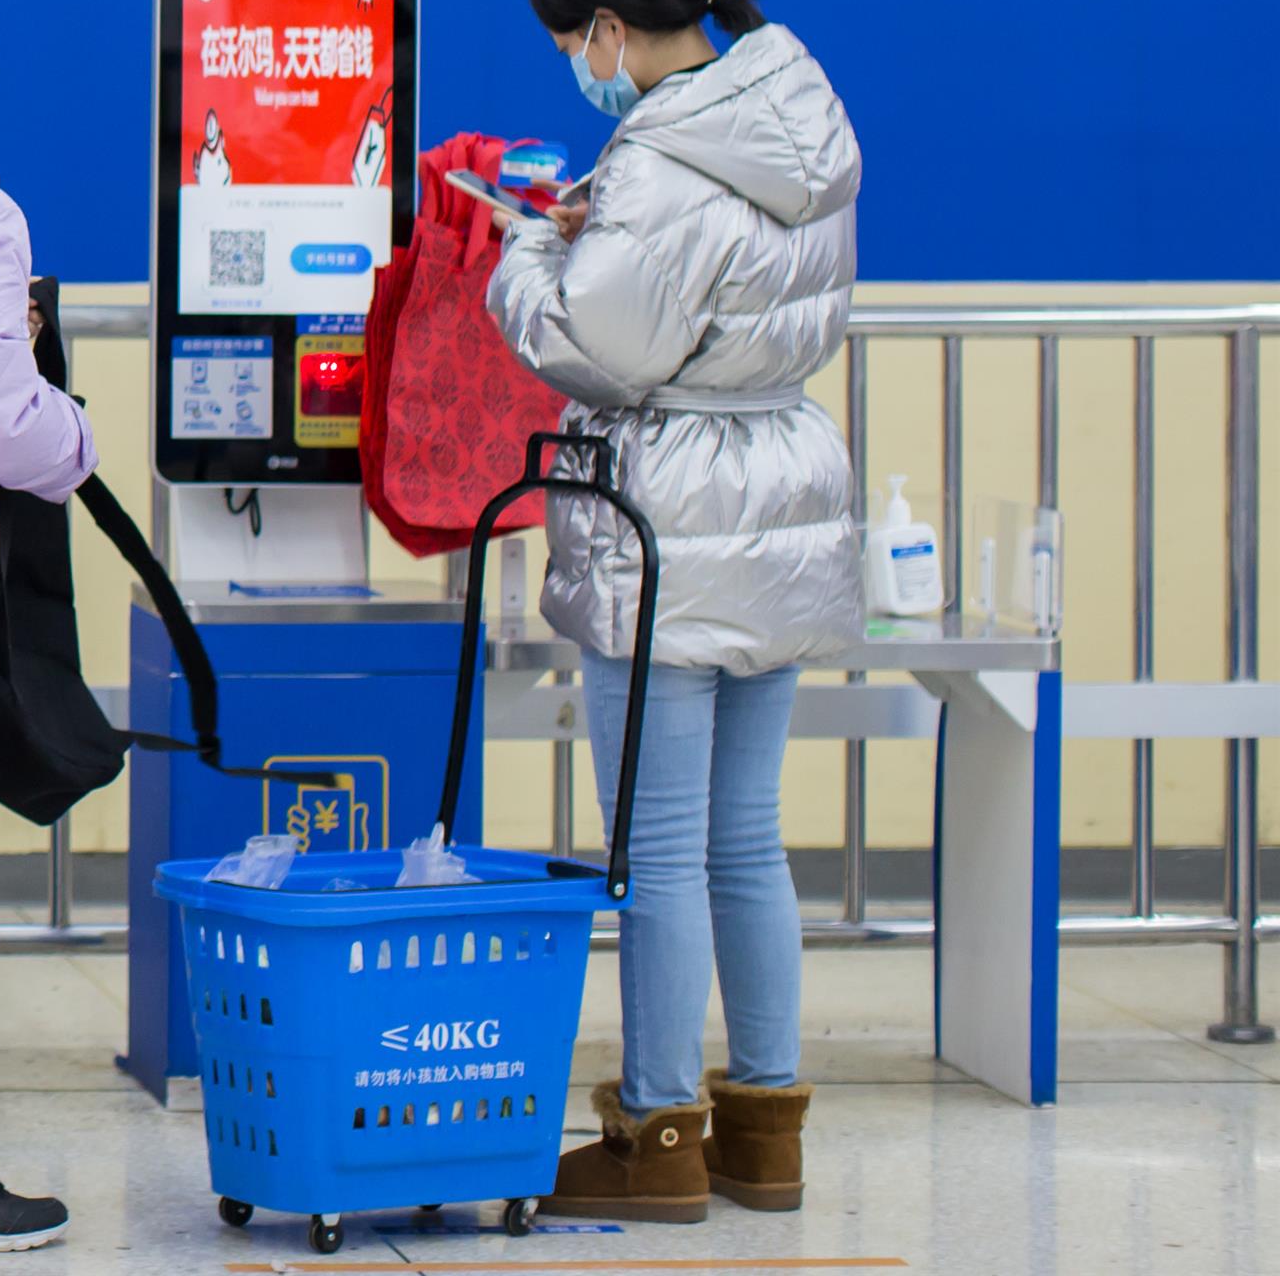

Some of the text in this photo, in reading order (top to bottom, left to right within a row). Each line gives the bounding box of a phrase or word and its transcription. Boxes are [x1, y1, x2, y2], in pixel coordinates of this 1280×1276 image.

[354, 1060, 526, 1088] 请勿将小孩放入购物篮内
